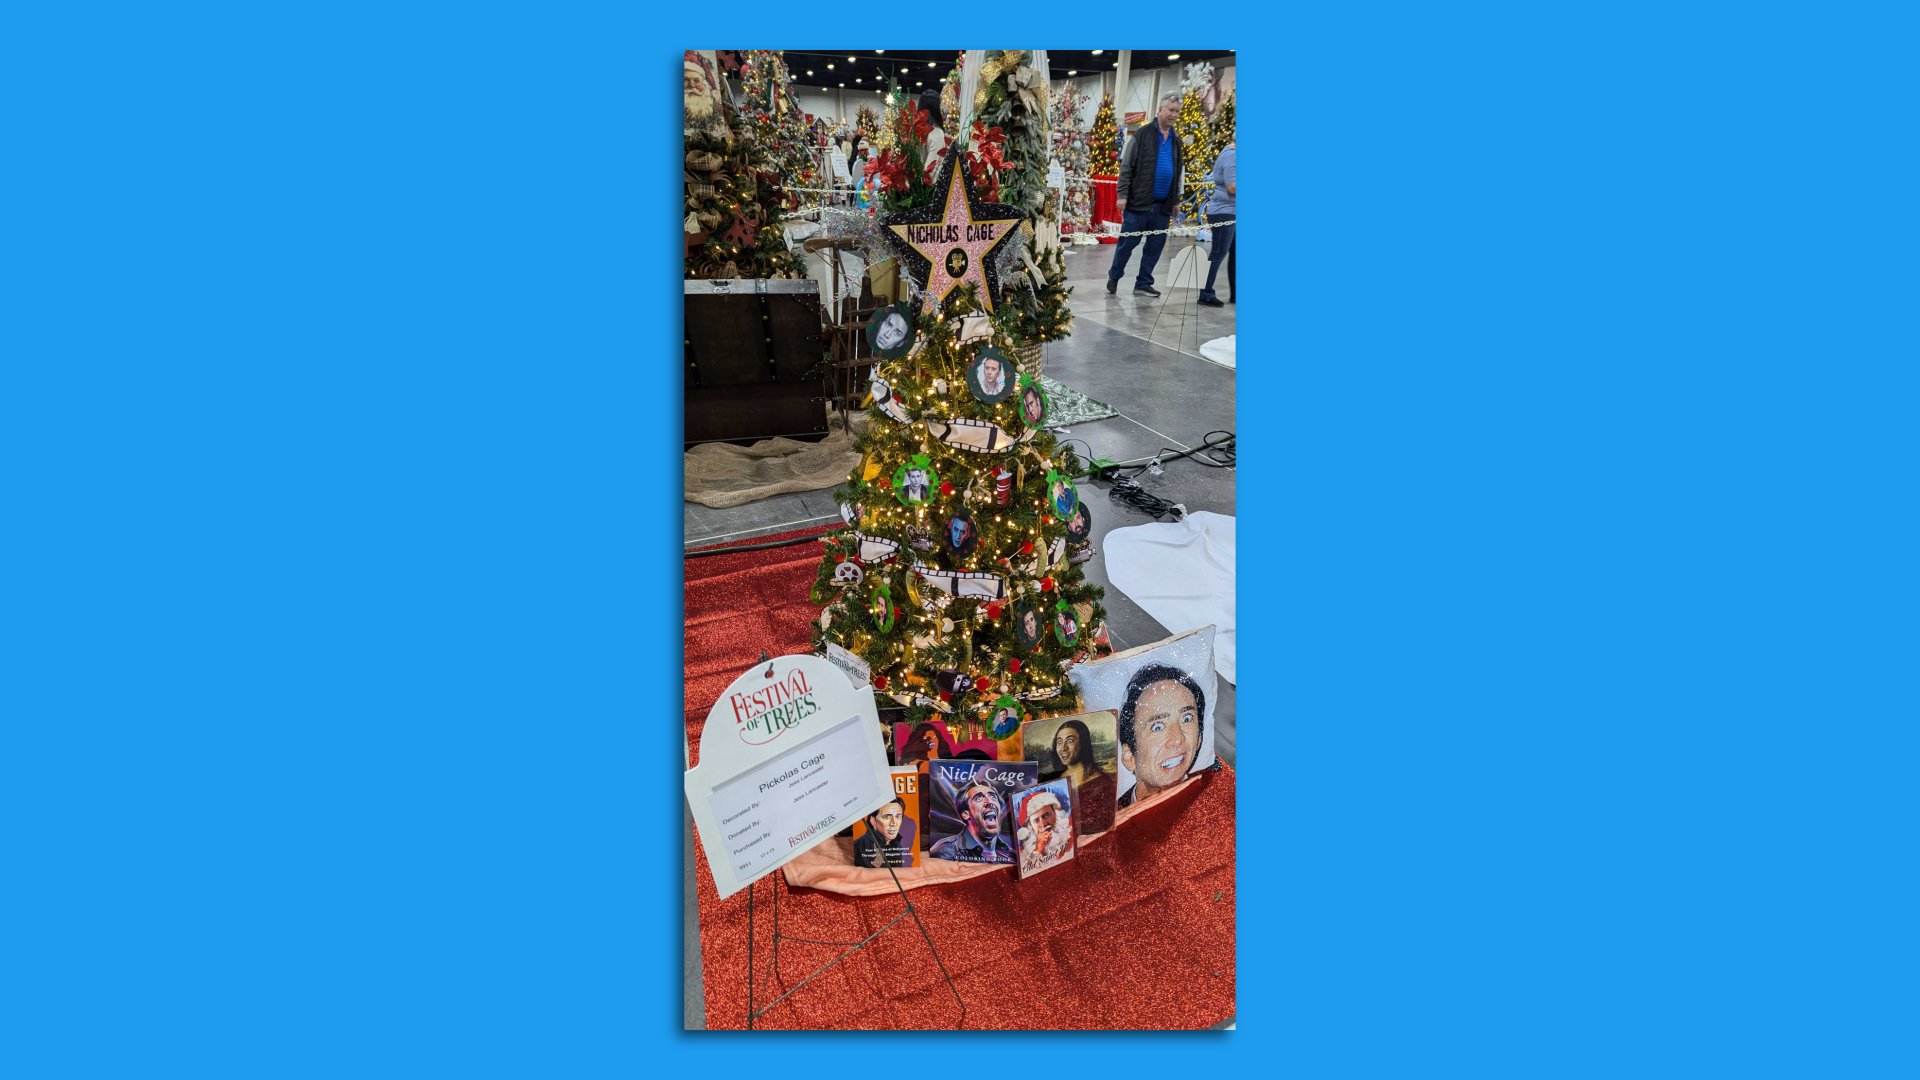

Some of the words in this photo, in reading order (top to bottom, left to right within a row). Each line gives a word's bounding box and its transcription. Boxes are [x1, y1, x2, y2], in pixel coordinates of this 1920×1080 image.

[907, 224, 959, 244] NICHOLAS
[966, 223, 994, 242] CAGE
[730, 668, 812, 724] FESTIVAL
[746, 716, 760, 731] OF
[760, 692, 816, 735] TREES
[758, 767, 799, 793] Pickolas
[800, 753, 825, 770] Cage
[788, 779, 800, 788] Jess
[800, 765, 824, 781] Lancaster
[895, 775, 916, 794] GE
[940, 763, 982, 787] Nick
[985, 767, 1025, 787] Cage
[793, 794, 805, 803] Jess
[805, 780, 829, 796] Lancaster
[722, 806, 751, 825] Decorated
[751, 801, 761, 809] By:
[728, 824, 752, 840] Donated
[752, 819, 761, 827] By:
[788, 825, 816, 848] FESTIVAL
[816, 814, 836, 830] TREES
[733, 836, 763, 855] Purchased
[762, 831, 772, 839] By:
[1022, 859, 1037, 874] Old
[1039, 849, 1058, 866] Saint
